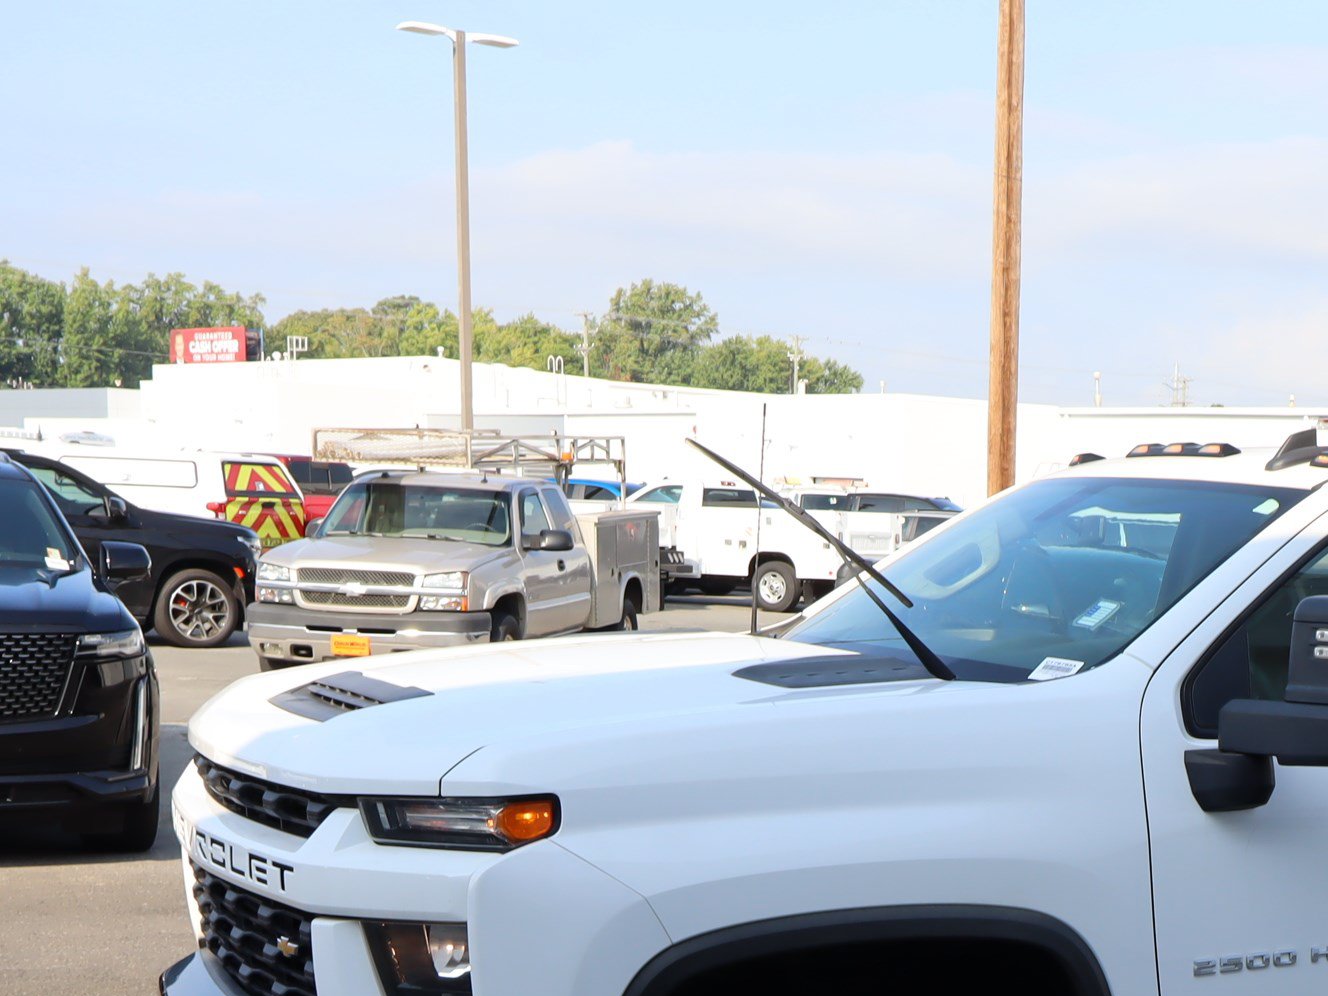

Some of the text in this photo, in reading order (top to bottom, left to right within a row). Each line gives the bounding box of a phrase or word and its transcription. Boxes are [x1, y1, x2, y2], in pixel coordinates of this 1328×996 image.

[188, 339, 239, 353] CASH OFFER
[1193, 949, 1297, 978] 2500
